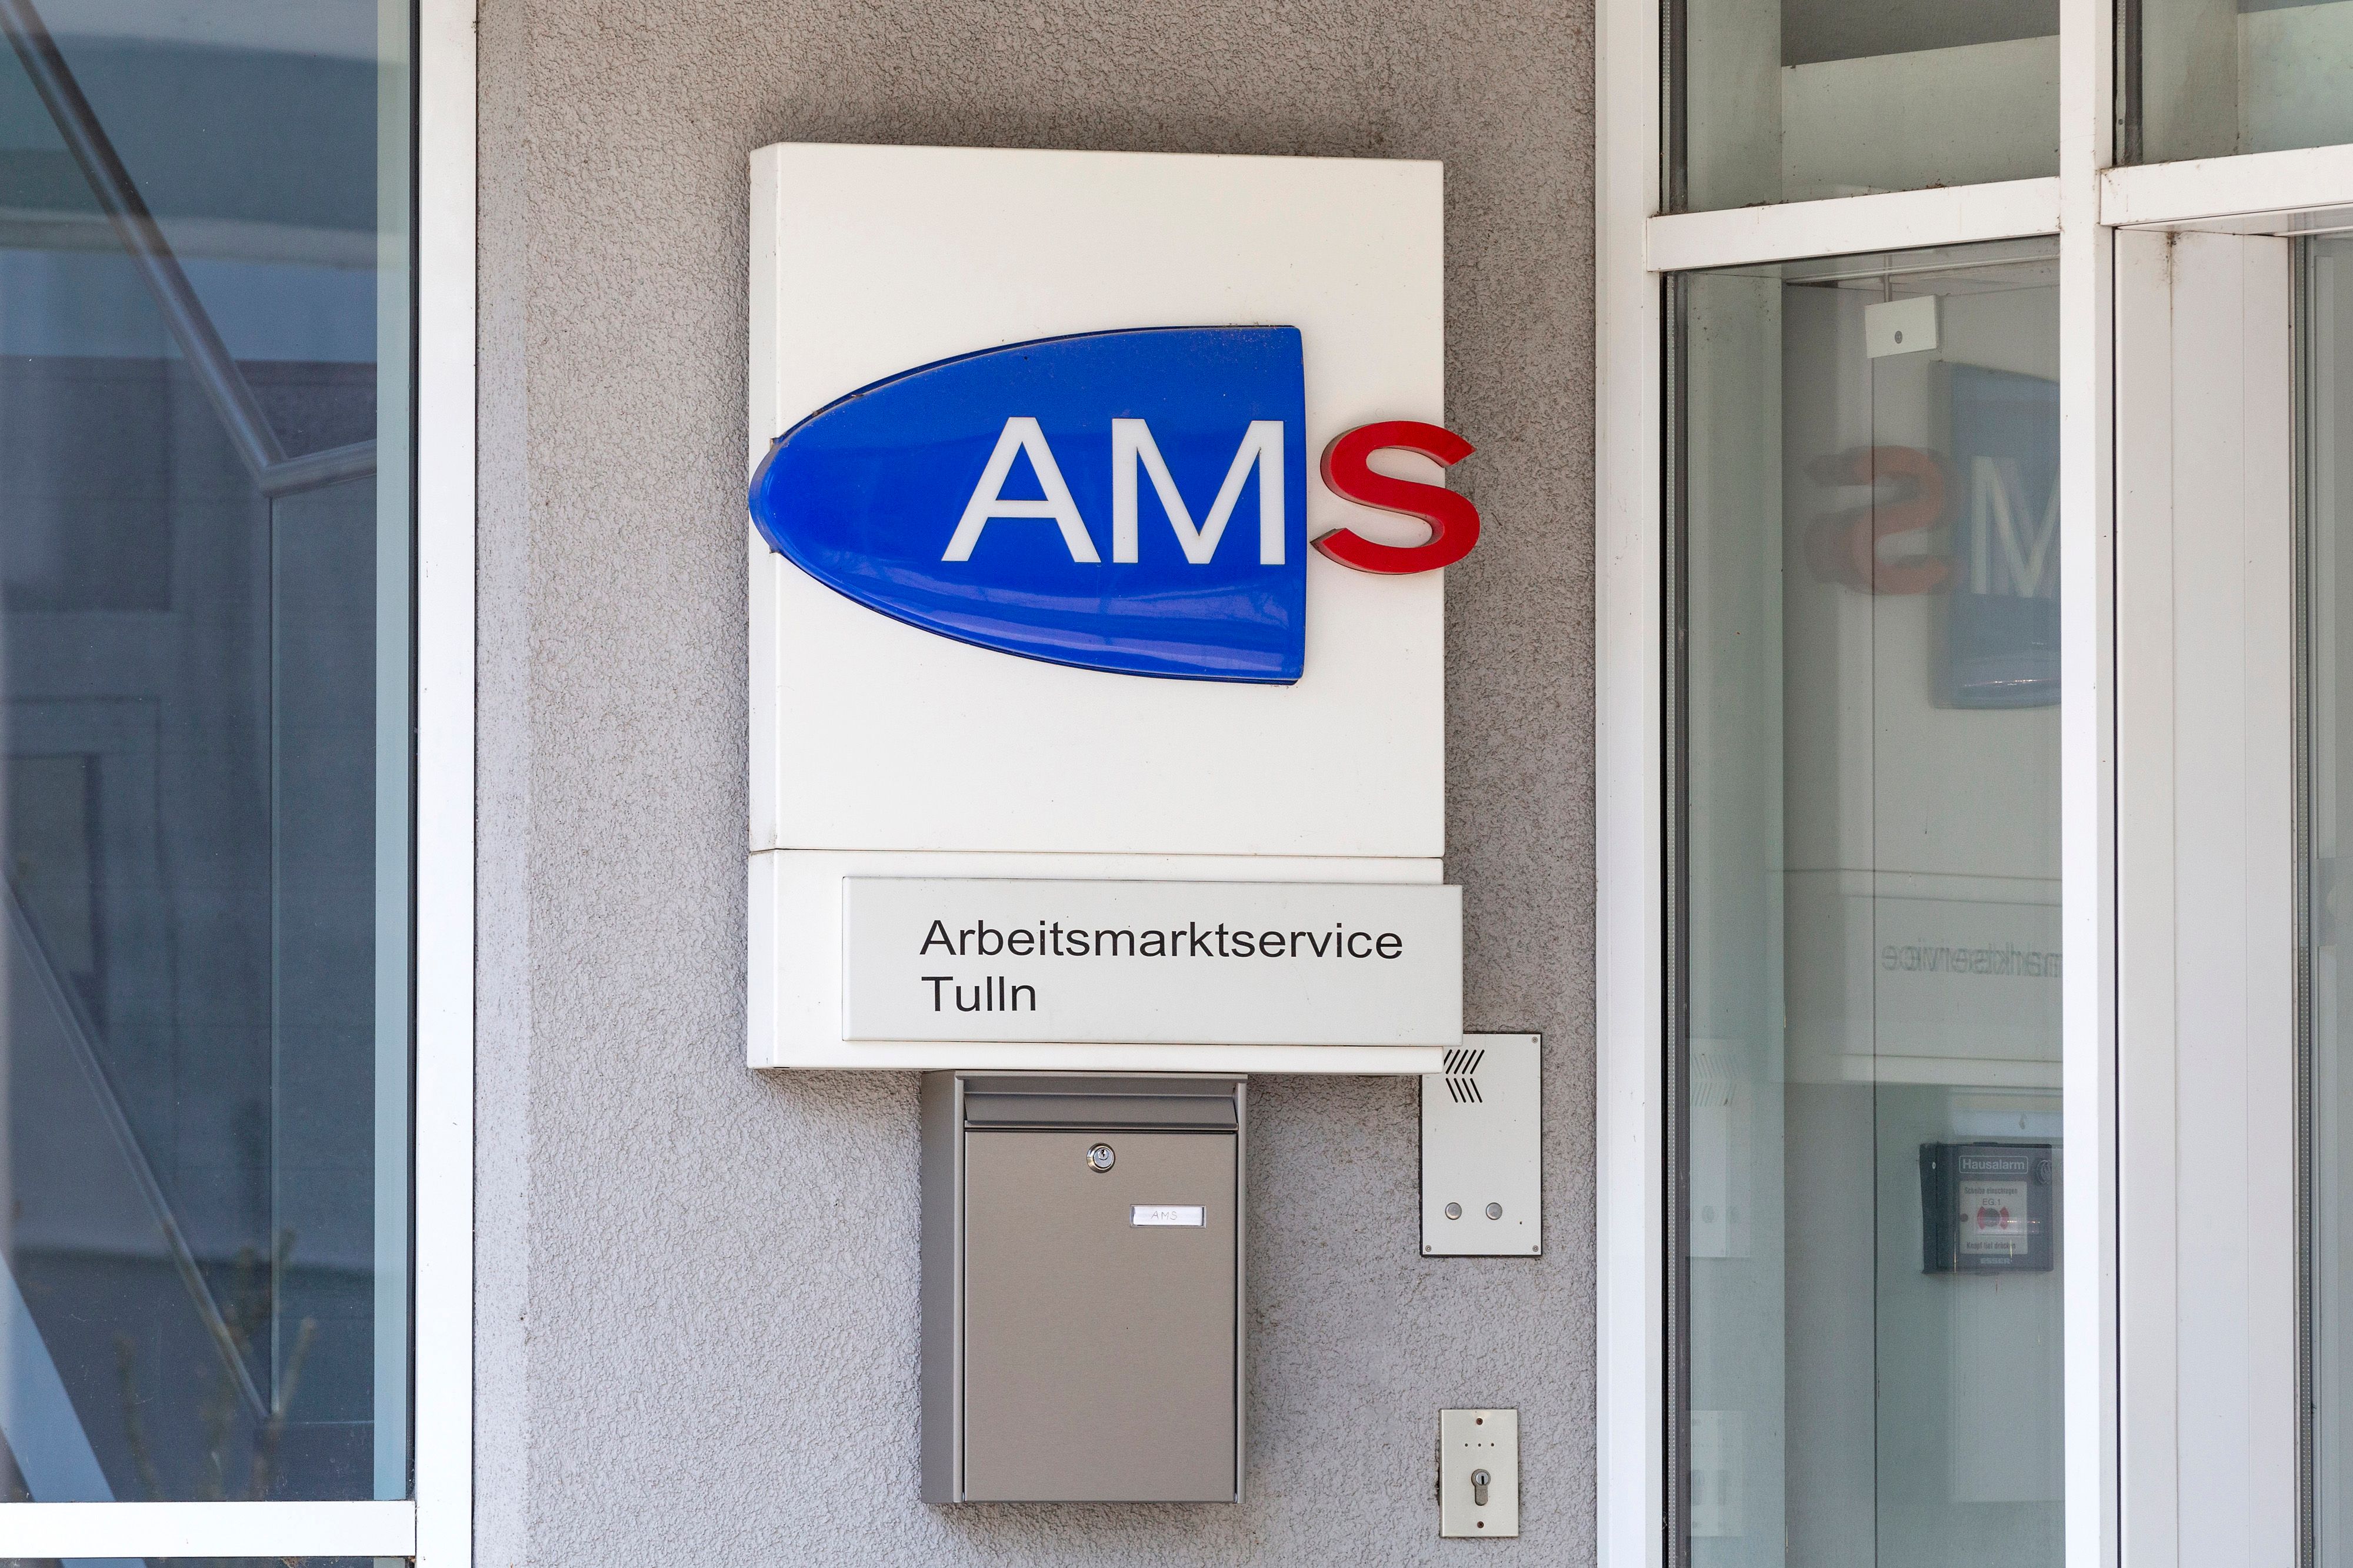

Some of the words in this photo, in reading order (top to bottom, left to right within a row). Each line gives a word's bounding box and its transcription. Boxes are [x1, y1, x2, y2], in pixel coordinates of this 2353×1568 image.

[941, 416, 1481, 575] AMS
[919, 919, 1403, 960] Arbeitsmarktservice
[921, 975, 1036, 1012] Tulln
[1962, 1159, 2025, 1170] Hausalarm
[1151, 1210, 1178, 1220] AMS
